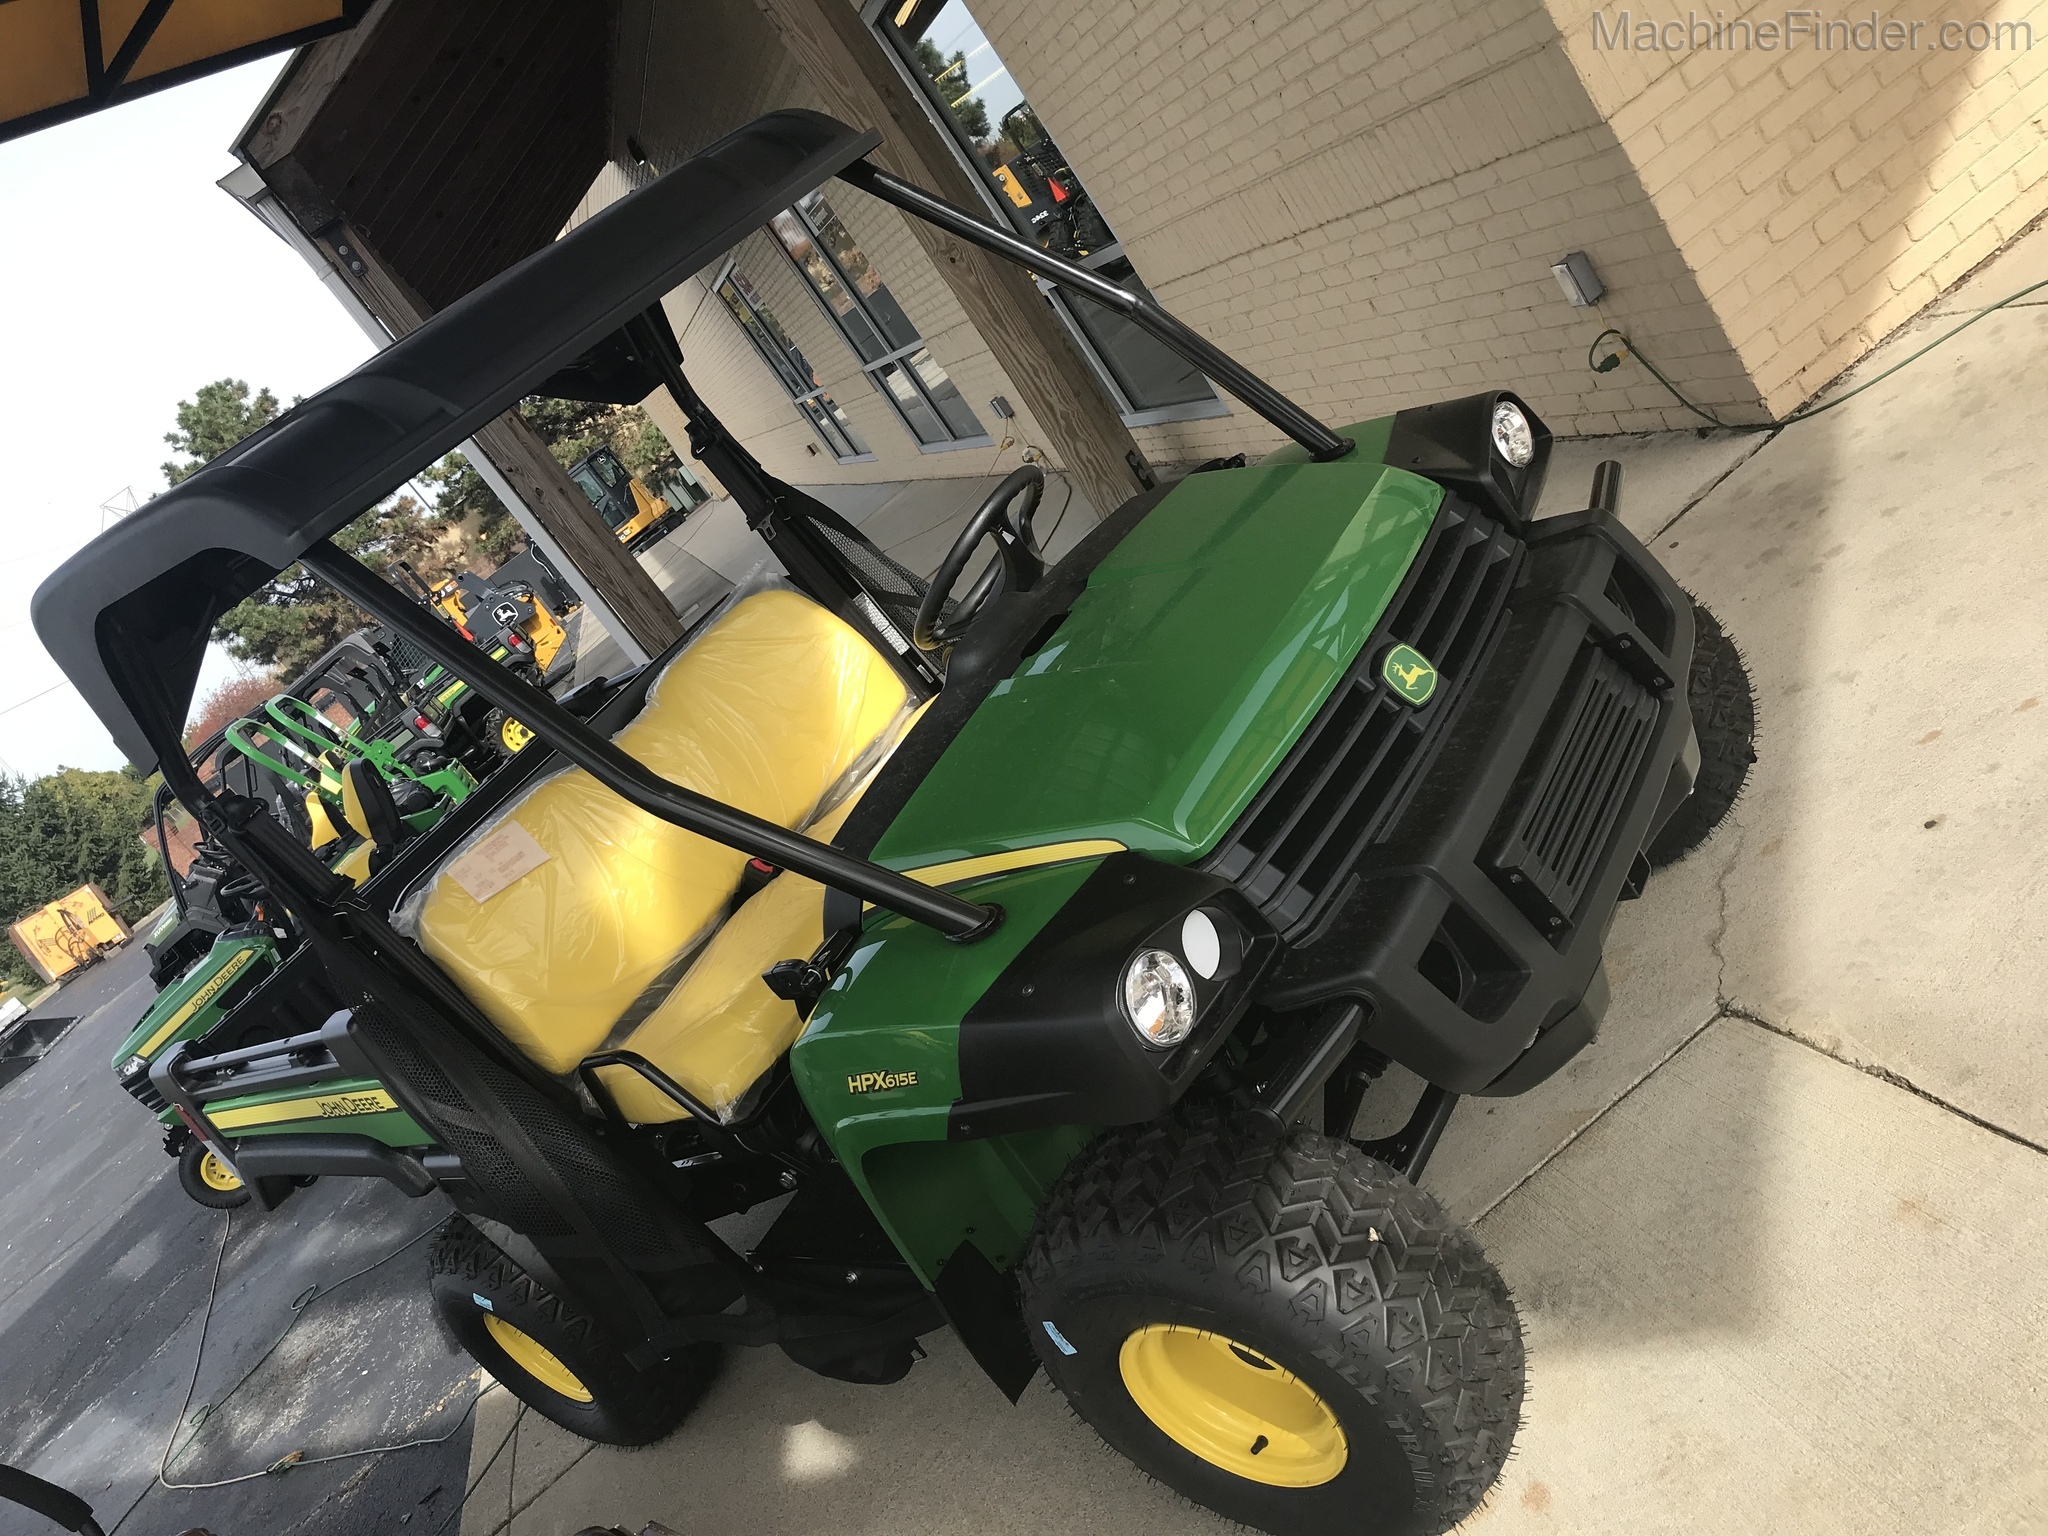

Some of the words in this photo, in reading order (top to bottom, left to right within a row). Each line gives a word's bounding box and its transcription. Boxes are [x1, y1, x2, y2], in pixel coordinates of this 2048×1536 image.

[191, 986, 216, 1013] JOHN
[216, 955, 246, 990] DEERE
[847, 1070, 918, 1094] HPX615E
[315, 1100, 349, 1116] JOHN
[341, 1097, 386, 1112] DEERE
[1310, 1345, 1379, 1406] ALL
